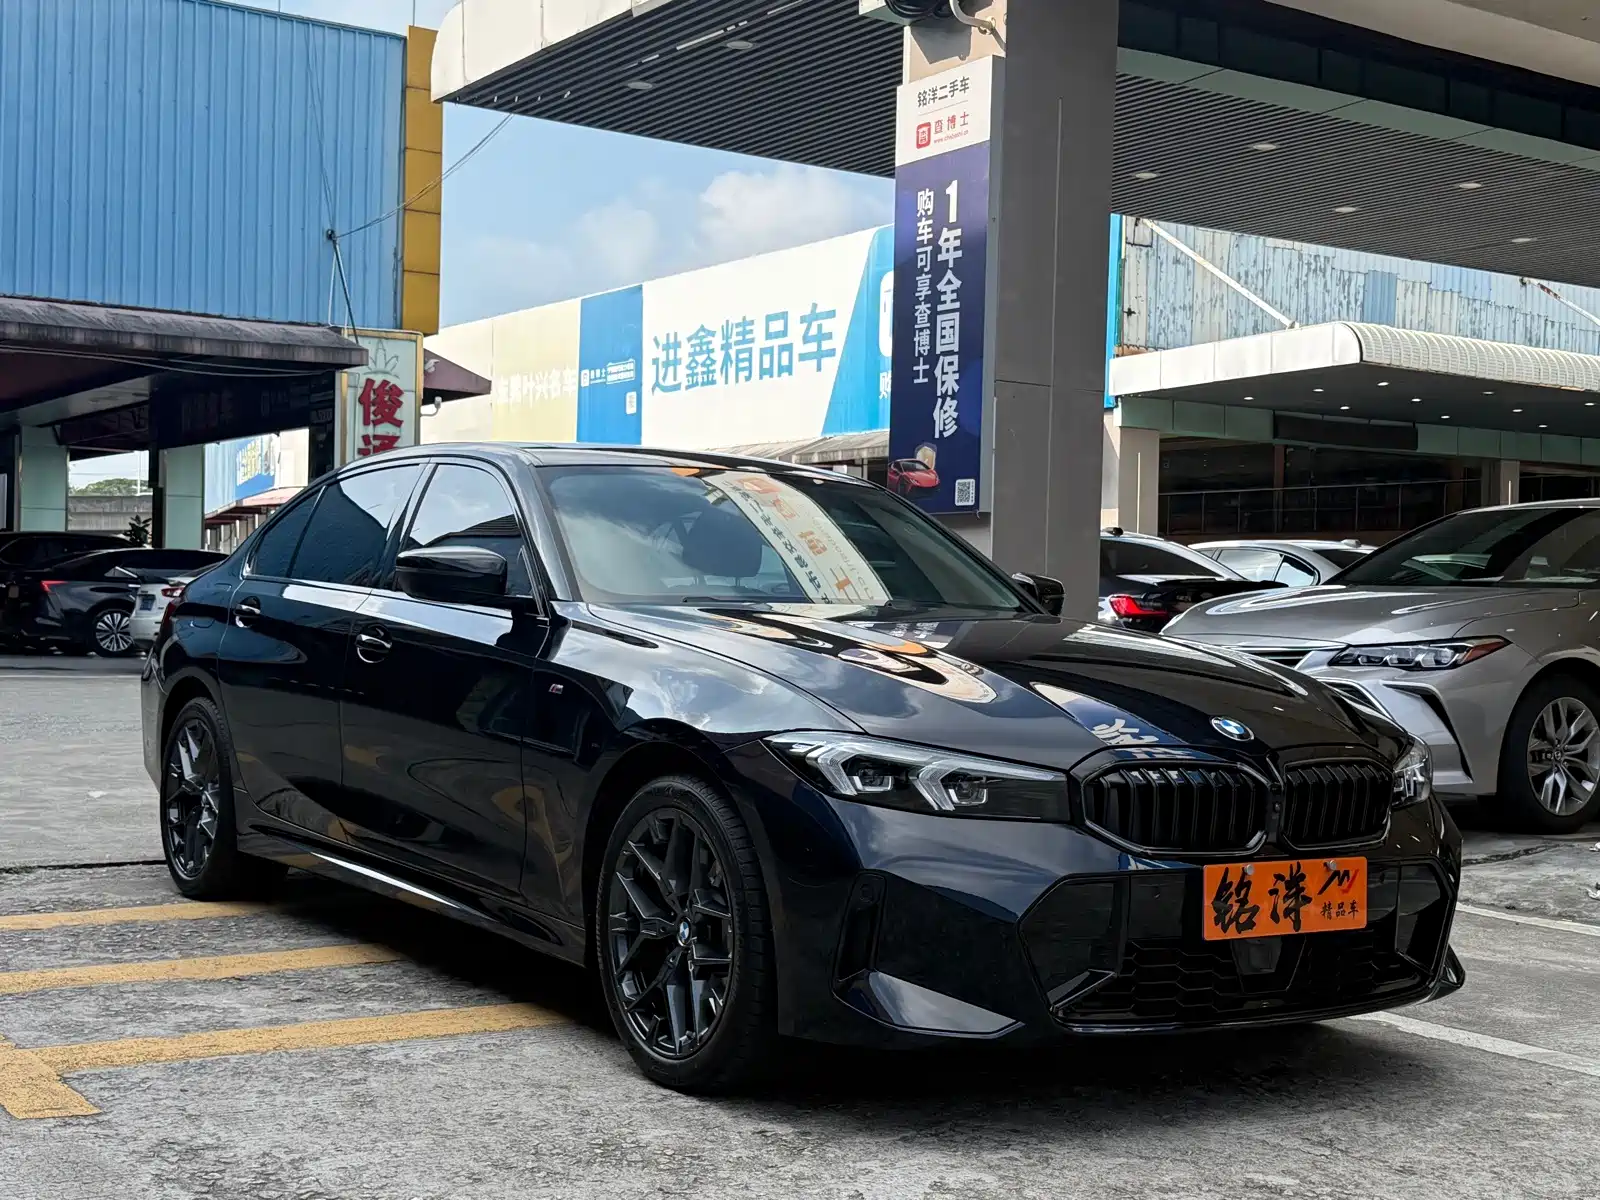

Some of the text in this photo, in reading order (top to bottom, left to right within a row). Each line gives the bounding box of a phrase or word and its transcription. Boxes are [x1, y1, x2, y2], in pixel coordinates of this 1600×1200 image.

[918, 76, 970, 108] 铭洋二手车
[934, 112, 969, 135] 查博士
[913, 188, 934, 384] 购车可享查博士
[932, 179, 962, 439] 1年全国保修
[651, 302, 837, 397] 进鑫精品车
[1320, 901, 1359, 920] 精品车
